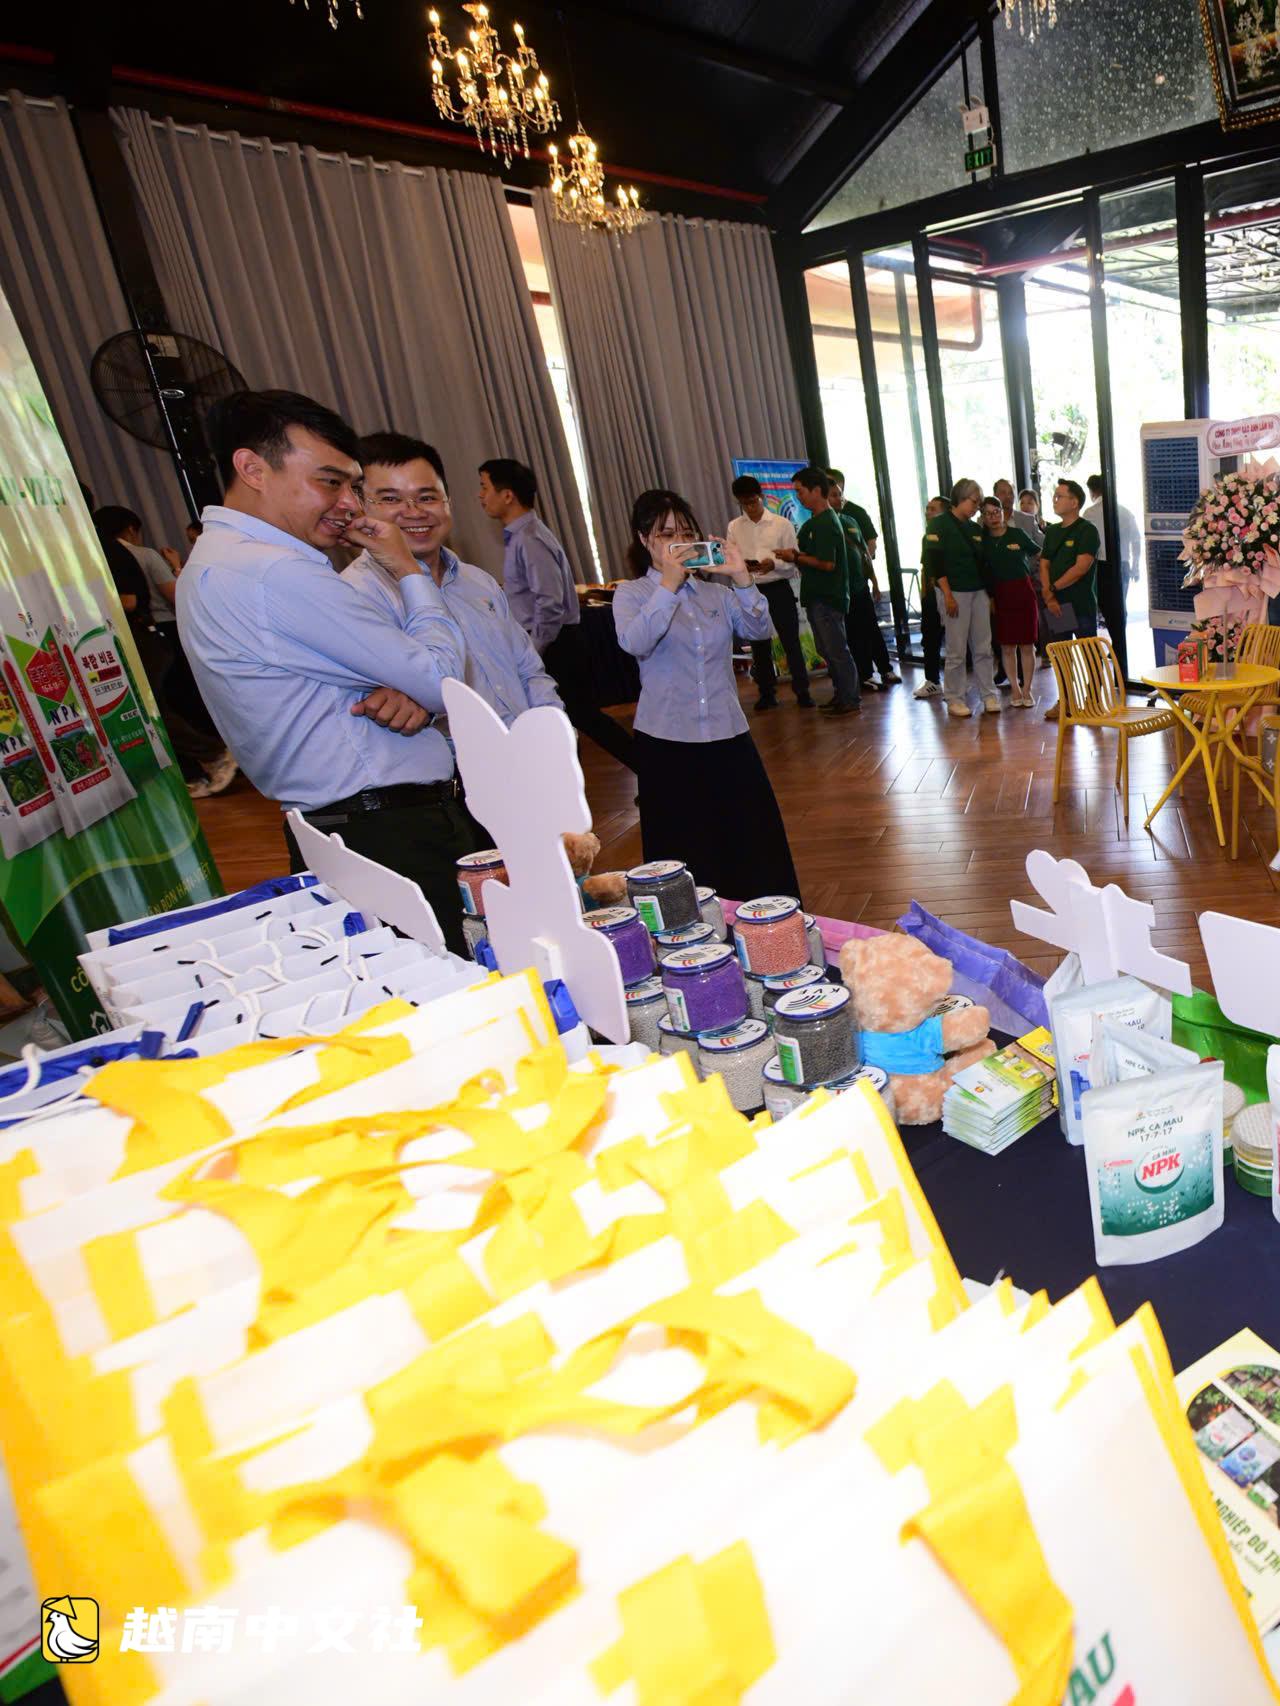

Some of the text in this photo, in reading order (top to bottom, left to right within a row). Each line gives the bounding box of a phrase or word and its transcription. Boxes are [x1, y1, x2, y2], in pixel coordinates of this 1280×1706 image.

[967, 146, 991, 170] EXIT
[1127, 1126, 1146, 1138] NPK
[1163, 1115, 1184, 1128] MAU
[1139, 1127, 1174, 1143] 17-7-17
[1142, 1153, 1181, 1181] NPK
